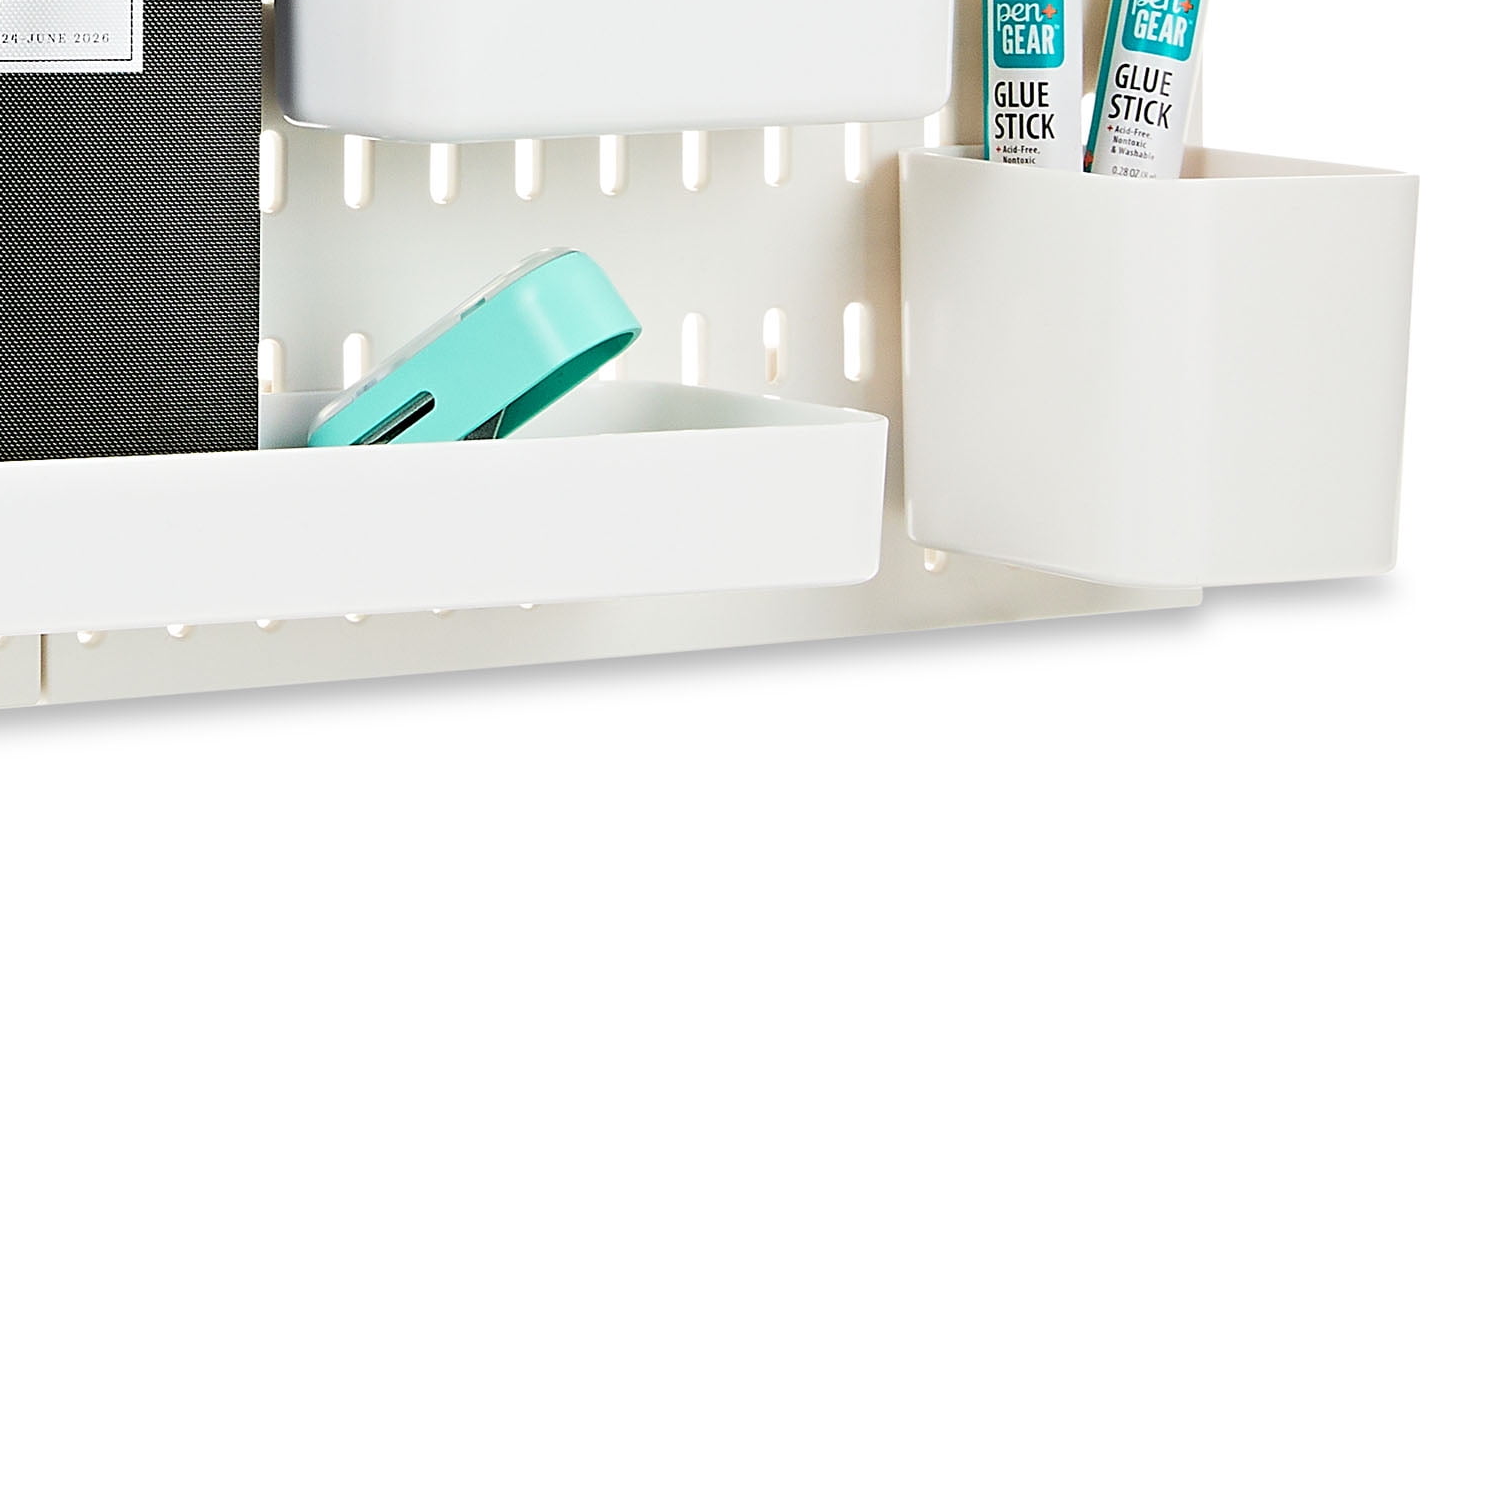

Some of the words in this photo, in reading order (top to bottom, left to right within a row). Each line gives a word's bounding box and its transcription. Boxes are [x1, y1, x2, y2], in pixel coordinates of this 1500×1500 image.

[73, 32, 110, 43] 2026
[1115, 63, 1173, 97] GLUE
[994, 81, 1049, 107] GLUE
[1108, 94, 1173, 129] STICK
[994, 113, 1055, 139] STICK
[1112, 135, 1147, 149] Nontoxic
[1002, 156, 1036, 164] Nontoxic
